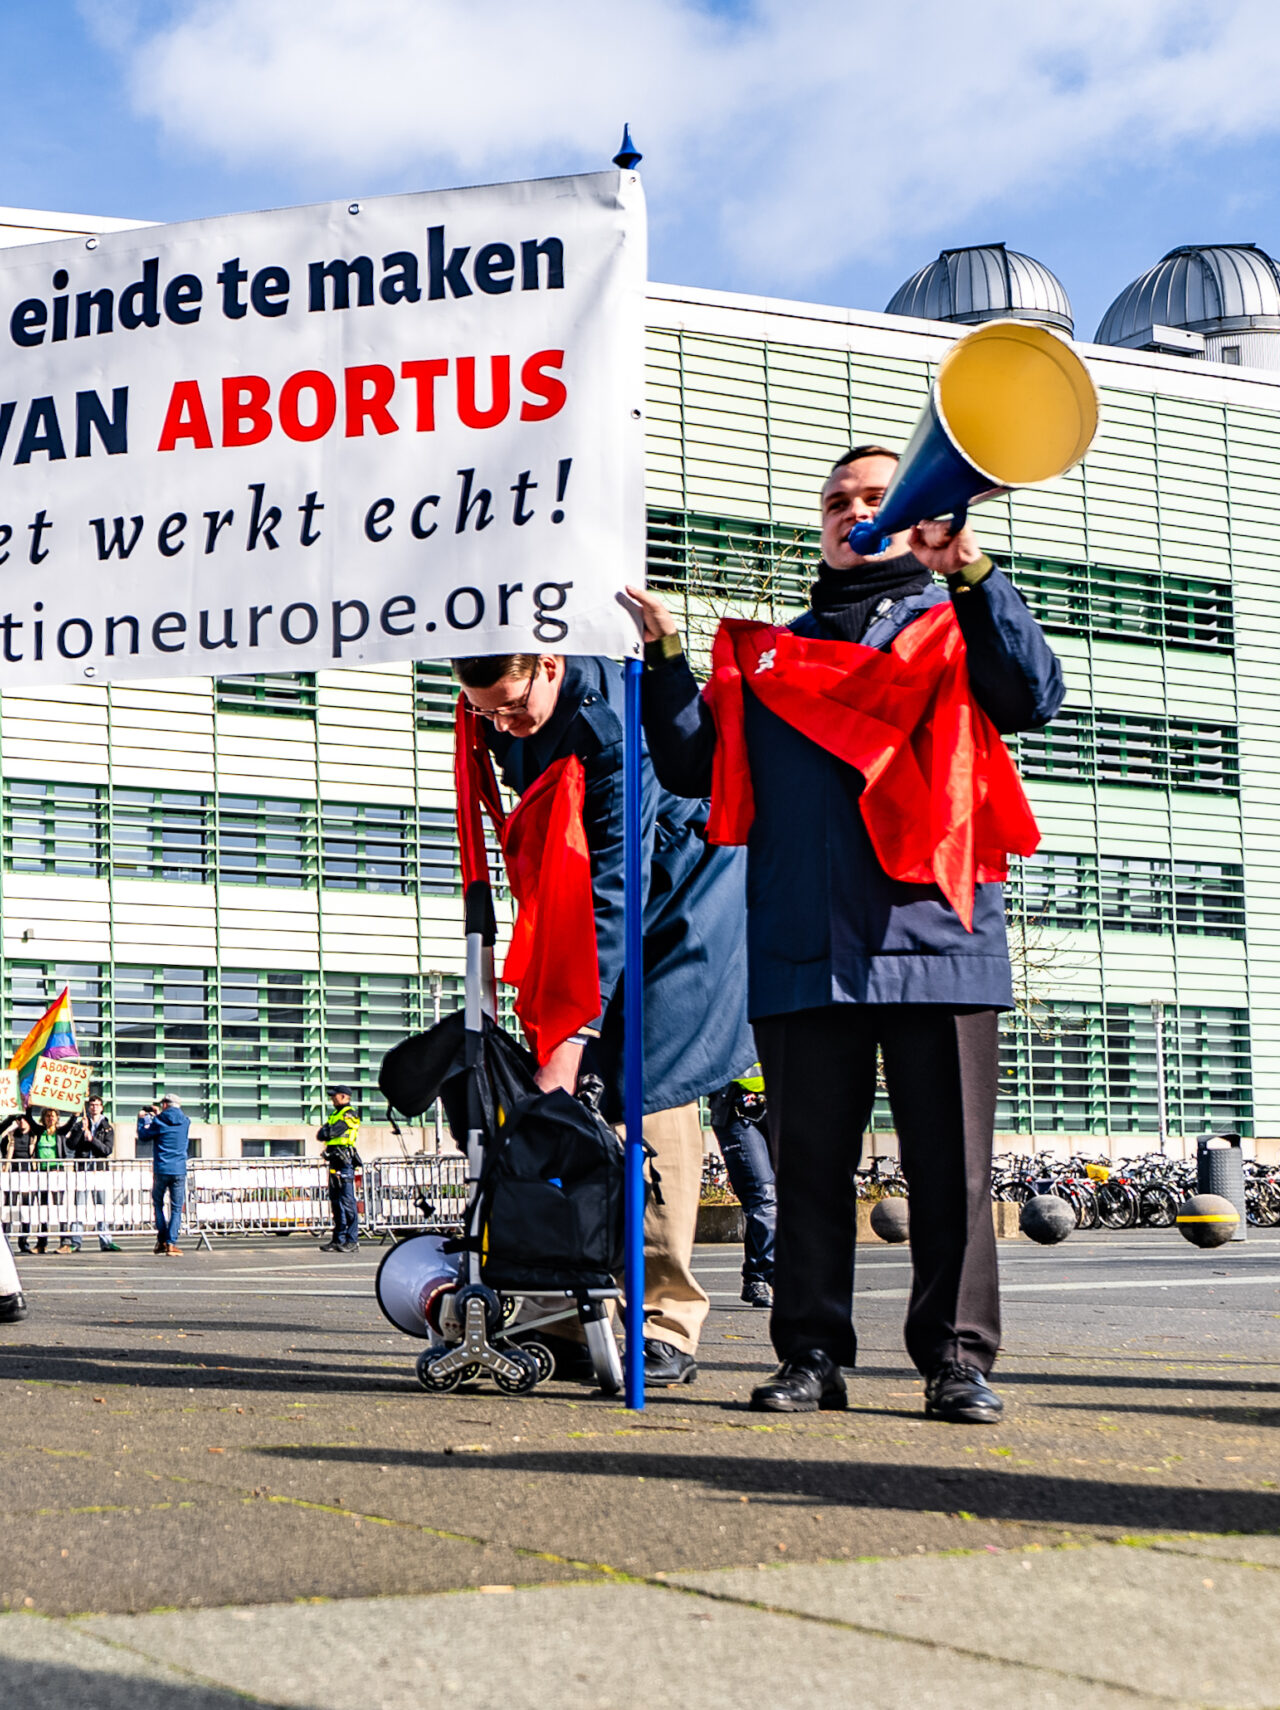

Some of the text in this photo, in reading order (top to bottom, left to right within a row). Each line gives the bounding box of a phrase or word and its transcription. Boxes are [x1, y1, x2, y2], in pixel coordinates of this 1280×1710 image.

[10, 257, 203, 348] einde
[217, 257, 290, 320] te
[308, 225, 567, 313] maken
[157, 349, 568, 453] ABORTUS
[88, 483, 325, 561] werkt
[364, 458, 573, 543] echt!
[32, 1085, 82, 1105] LEVENS
[40, 1061, 87, 1079] ABORTUS
[44, 1074, 81, 1089] REDT
